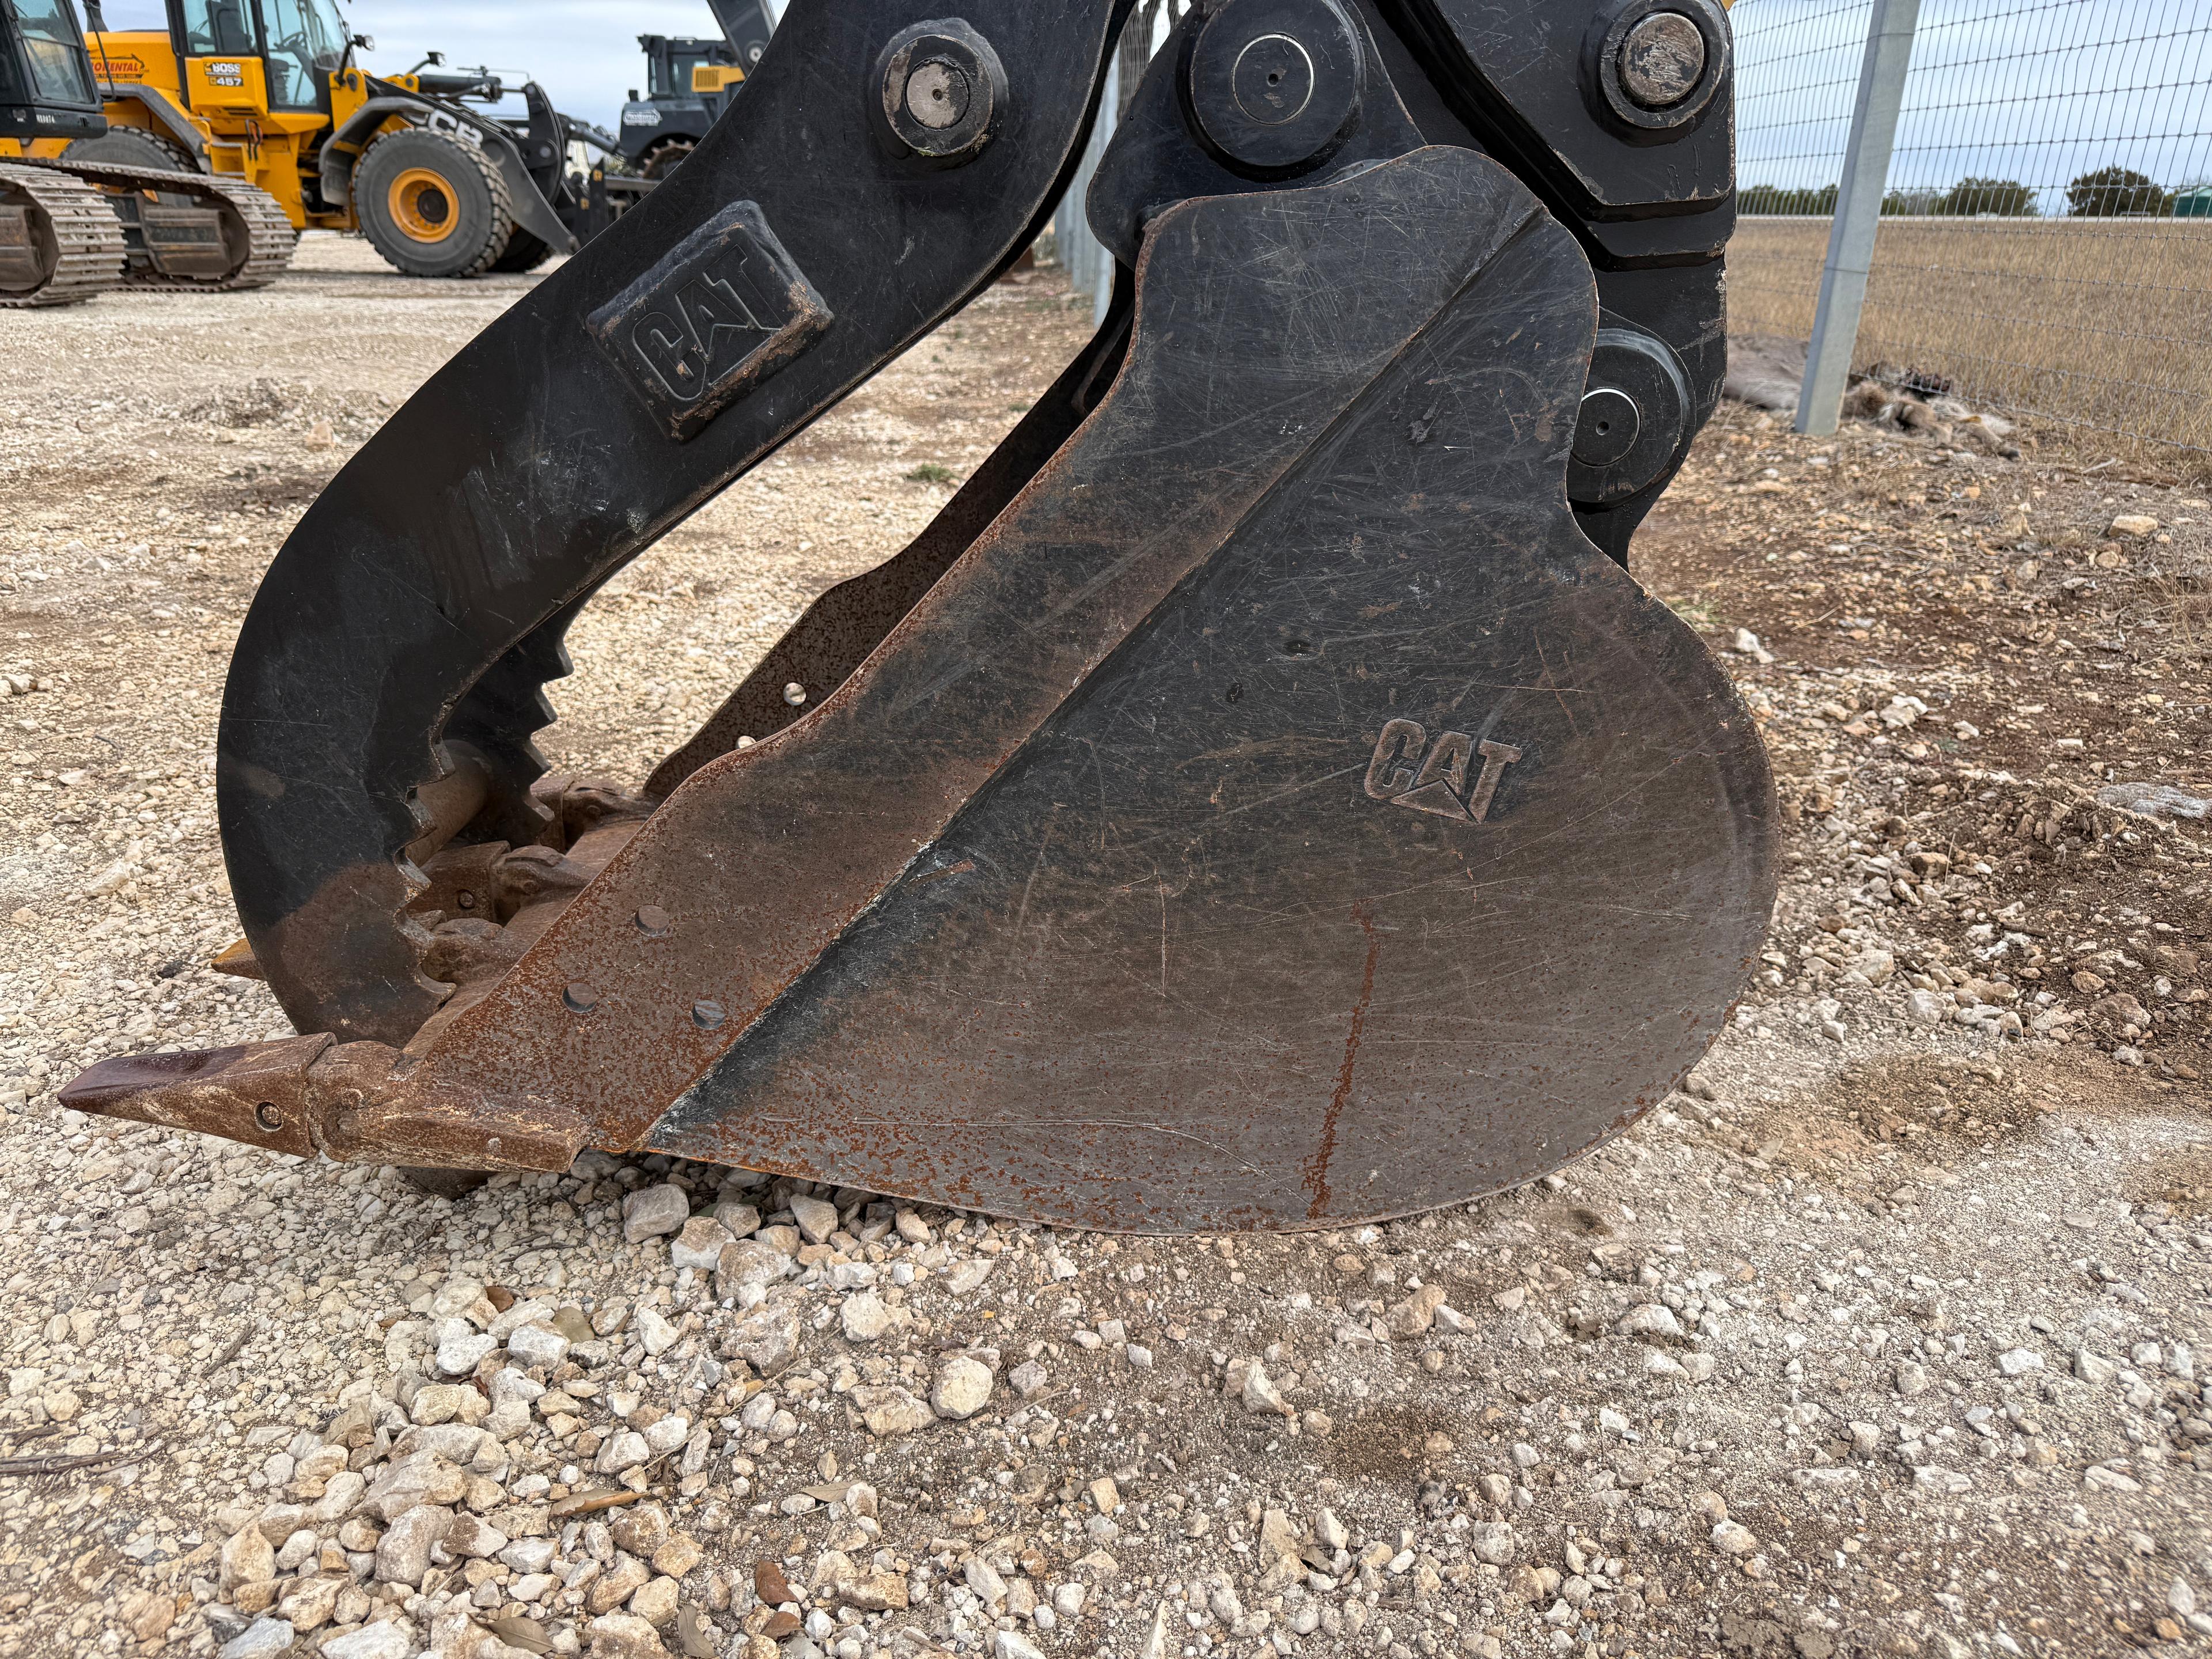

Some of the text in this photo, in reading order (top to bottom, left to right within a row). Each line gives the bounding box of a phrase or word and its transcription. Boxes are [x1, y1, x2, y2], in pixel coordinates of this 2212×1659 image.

[217, 77, 242, 86] 457
[632, 244, 783, 401] CAT
[1363, 718, 1524, 824] CAT
